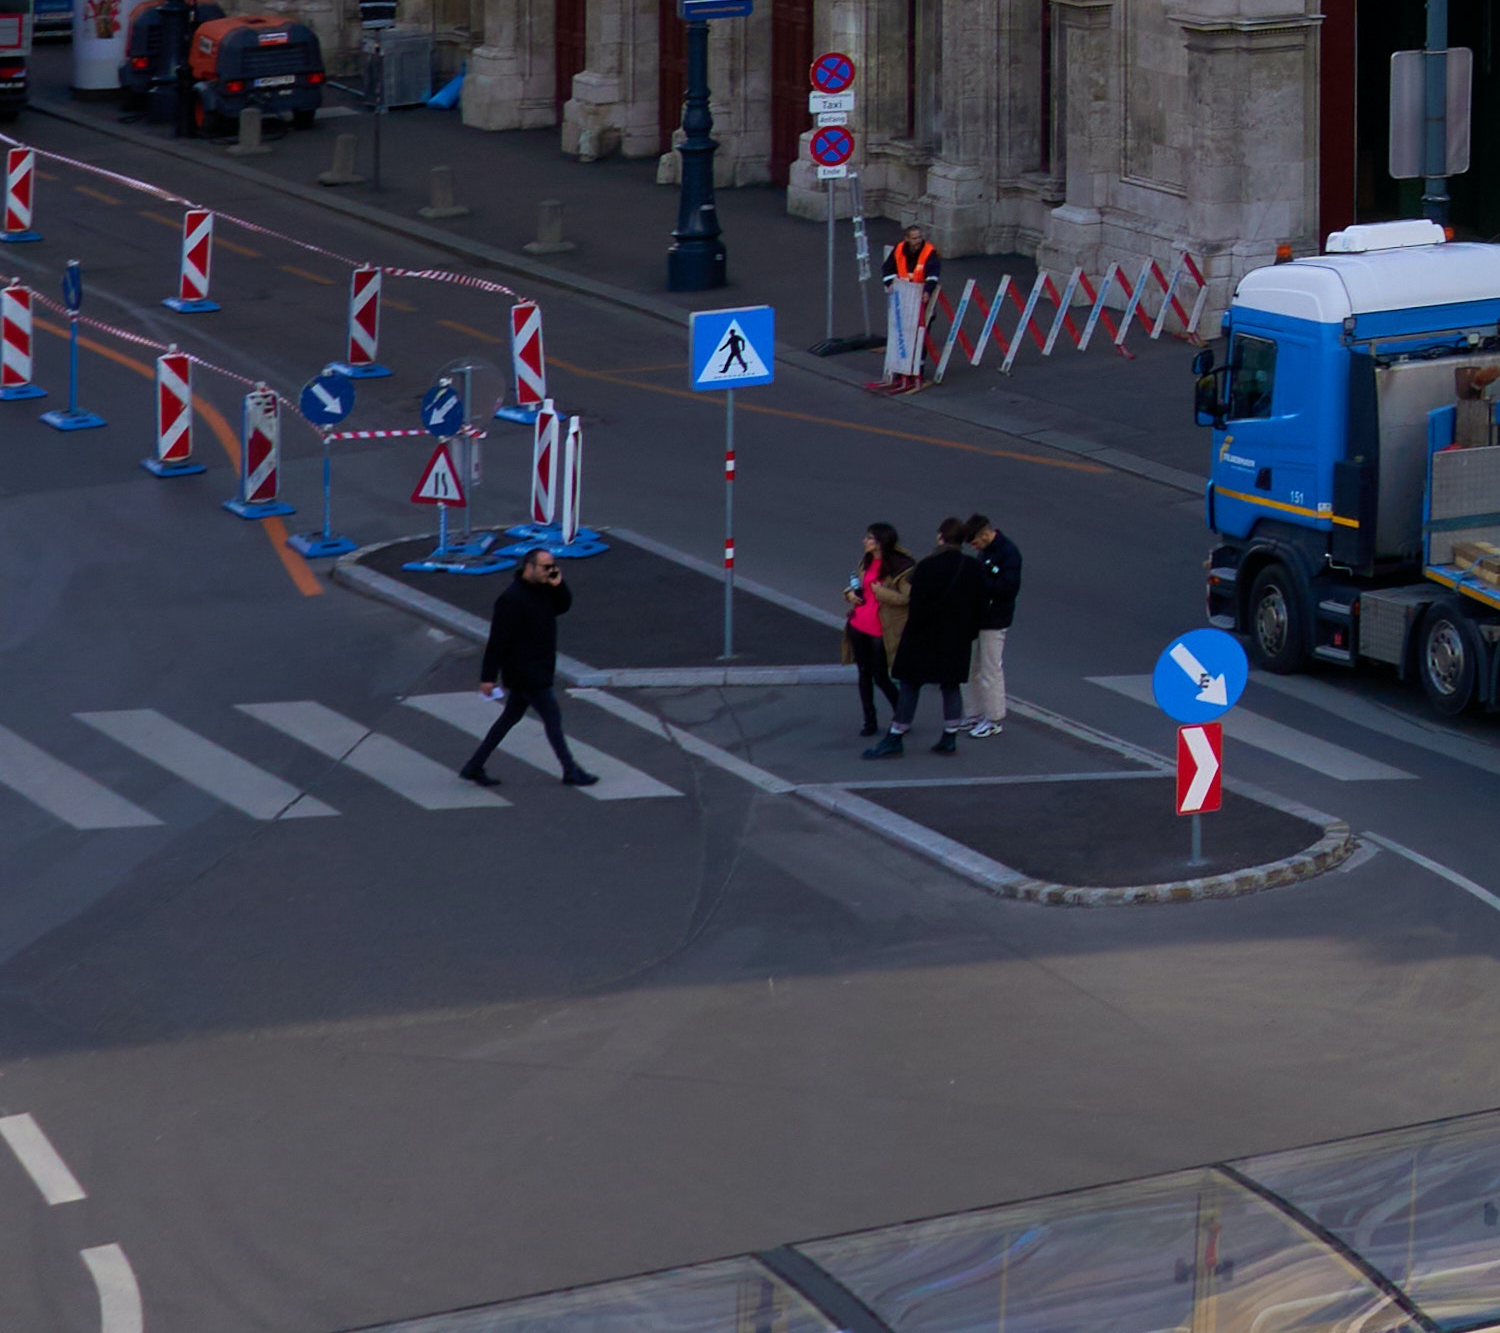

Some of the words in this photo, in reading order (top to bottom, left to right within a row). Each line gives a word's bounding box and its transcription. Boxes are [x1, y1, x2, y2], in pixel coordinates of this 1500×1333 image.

[822, 100, 843, 110] Taxi
[822, 168, 841, 176] Ende
[1290, 490, 1304, 505] 151
